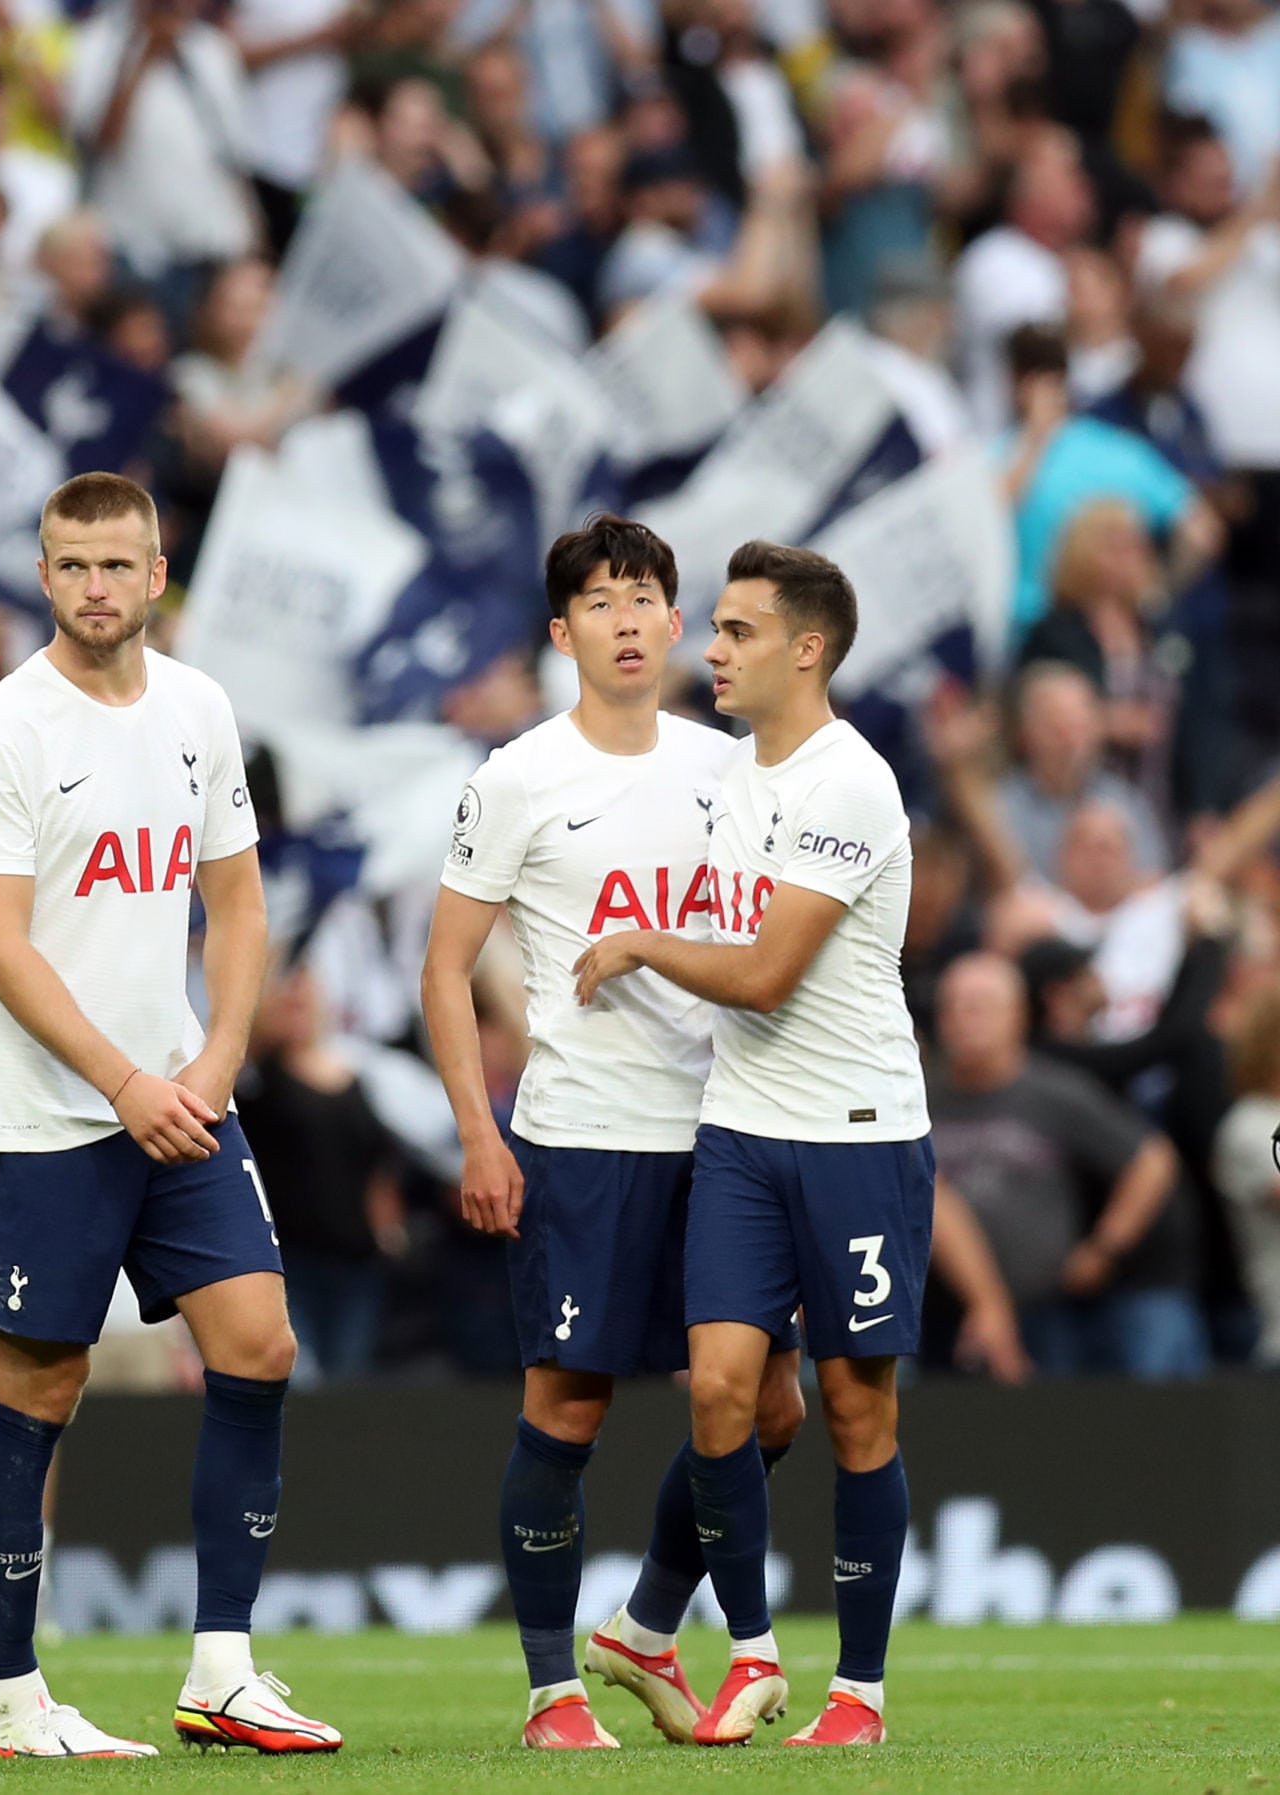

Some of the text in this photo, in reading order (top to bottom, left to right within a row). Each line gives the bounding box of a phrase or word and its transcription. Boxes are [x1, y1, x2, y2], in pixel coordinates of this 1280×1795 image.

[74, 824, 194, 897] AIA
[798, 825, 872, 868] cinch
[848, 1233, 892, 1307] 3
